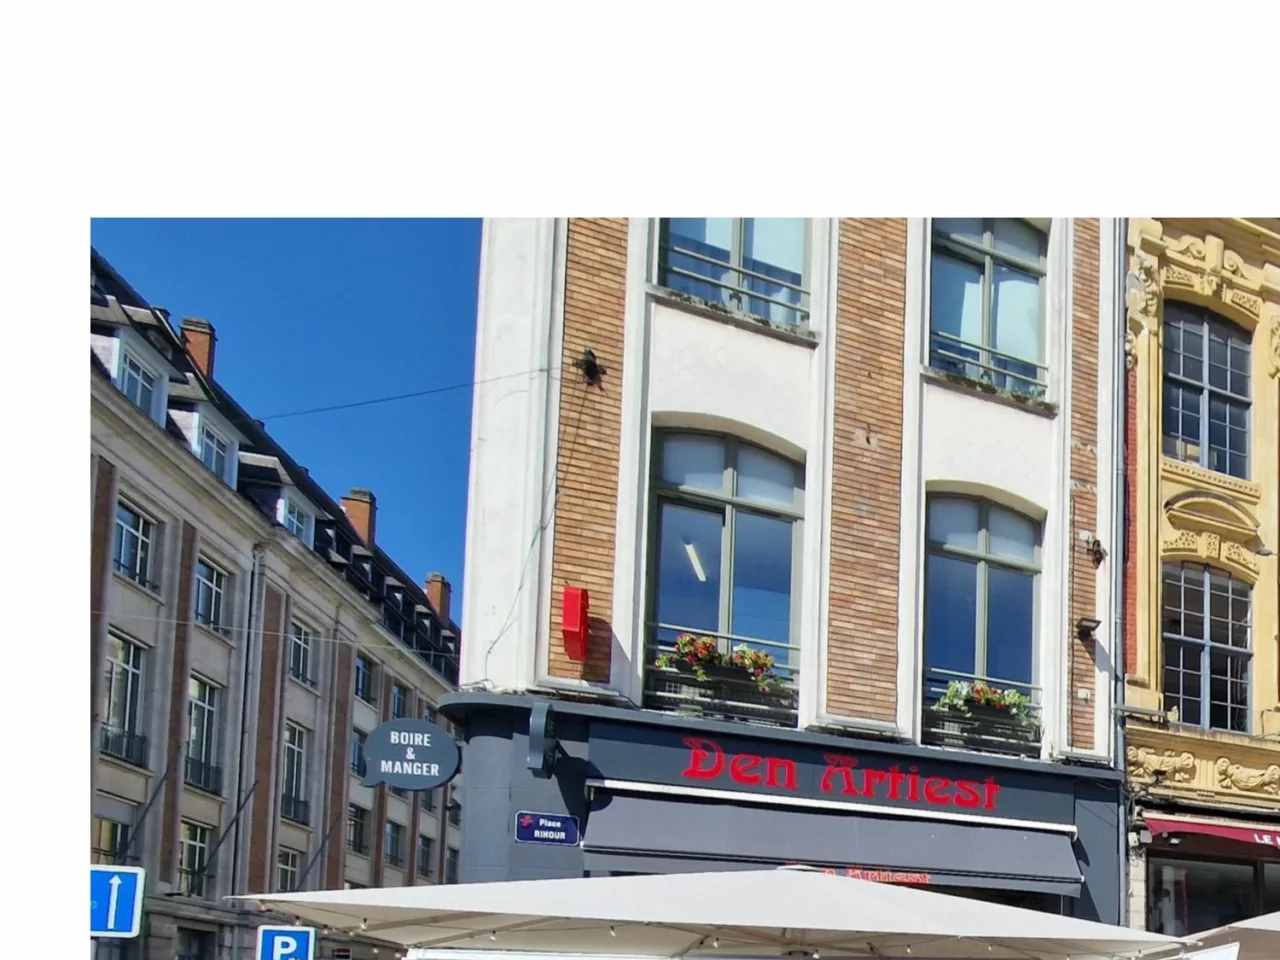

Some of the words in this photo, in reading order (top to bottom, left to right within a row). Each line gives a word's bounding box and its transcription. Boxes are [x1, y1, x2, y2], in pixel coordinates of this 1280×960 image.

[390, 731, 431, 747] BOIRE
[406, 747, 416, 760] &
[380, 760, 440, 777] MANGER
[681, 736, 799, 790] Den
[539, 818, 562, 828] Place
[533, 829, 566, 840] RIHOUR
[1253, 833, 1274, 845] LE
[272, 935, 298, 960] P
